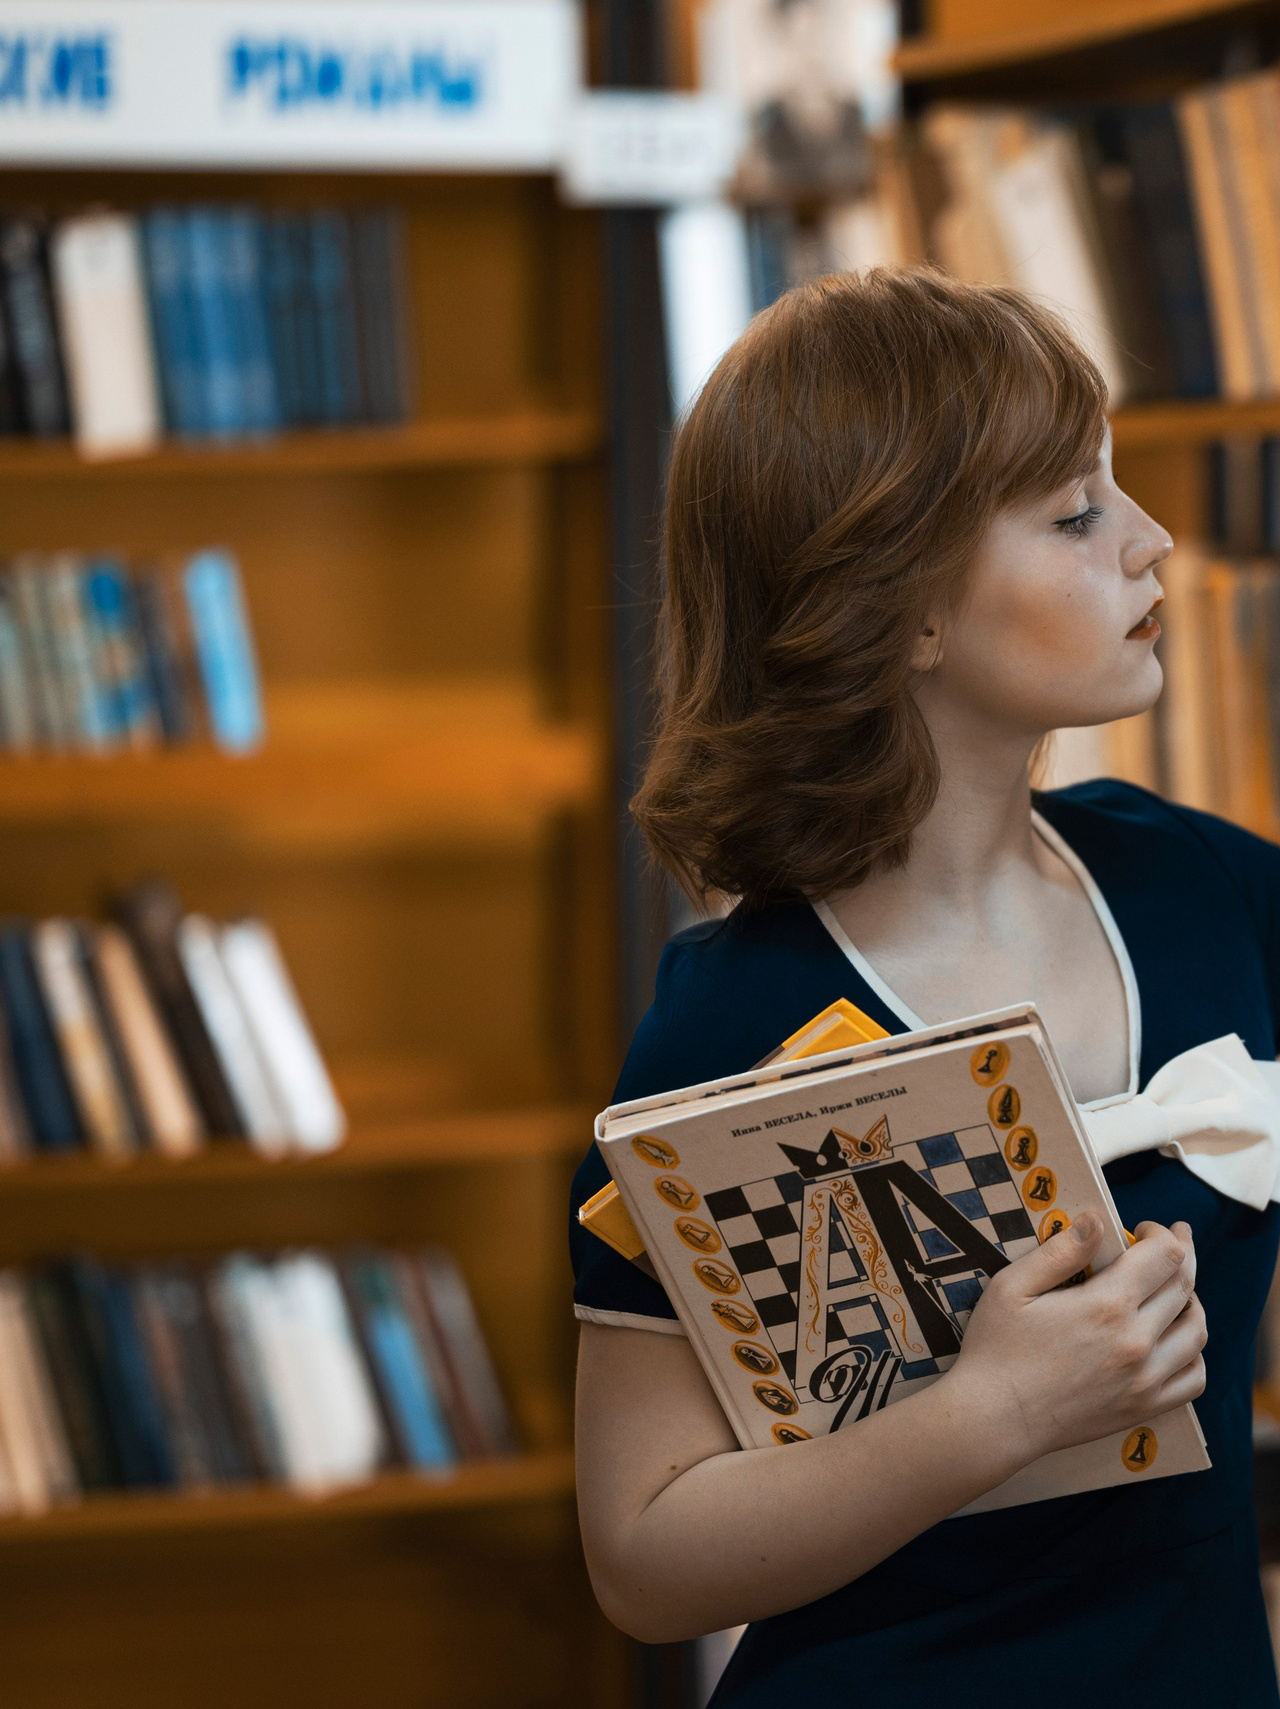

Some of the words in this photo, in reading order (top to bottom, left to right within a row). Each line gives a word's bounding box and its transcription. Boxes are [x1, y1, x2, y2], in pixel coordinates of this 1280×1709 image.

[731, 1124, 762, 1138] Инна
[764, 1110, 818, 1129] ВЕСЕЛА,
[819, 1101, 853, 1117] Иржи
[854, 1086, 907, 1106] ВЕСЕЛЫ
